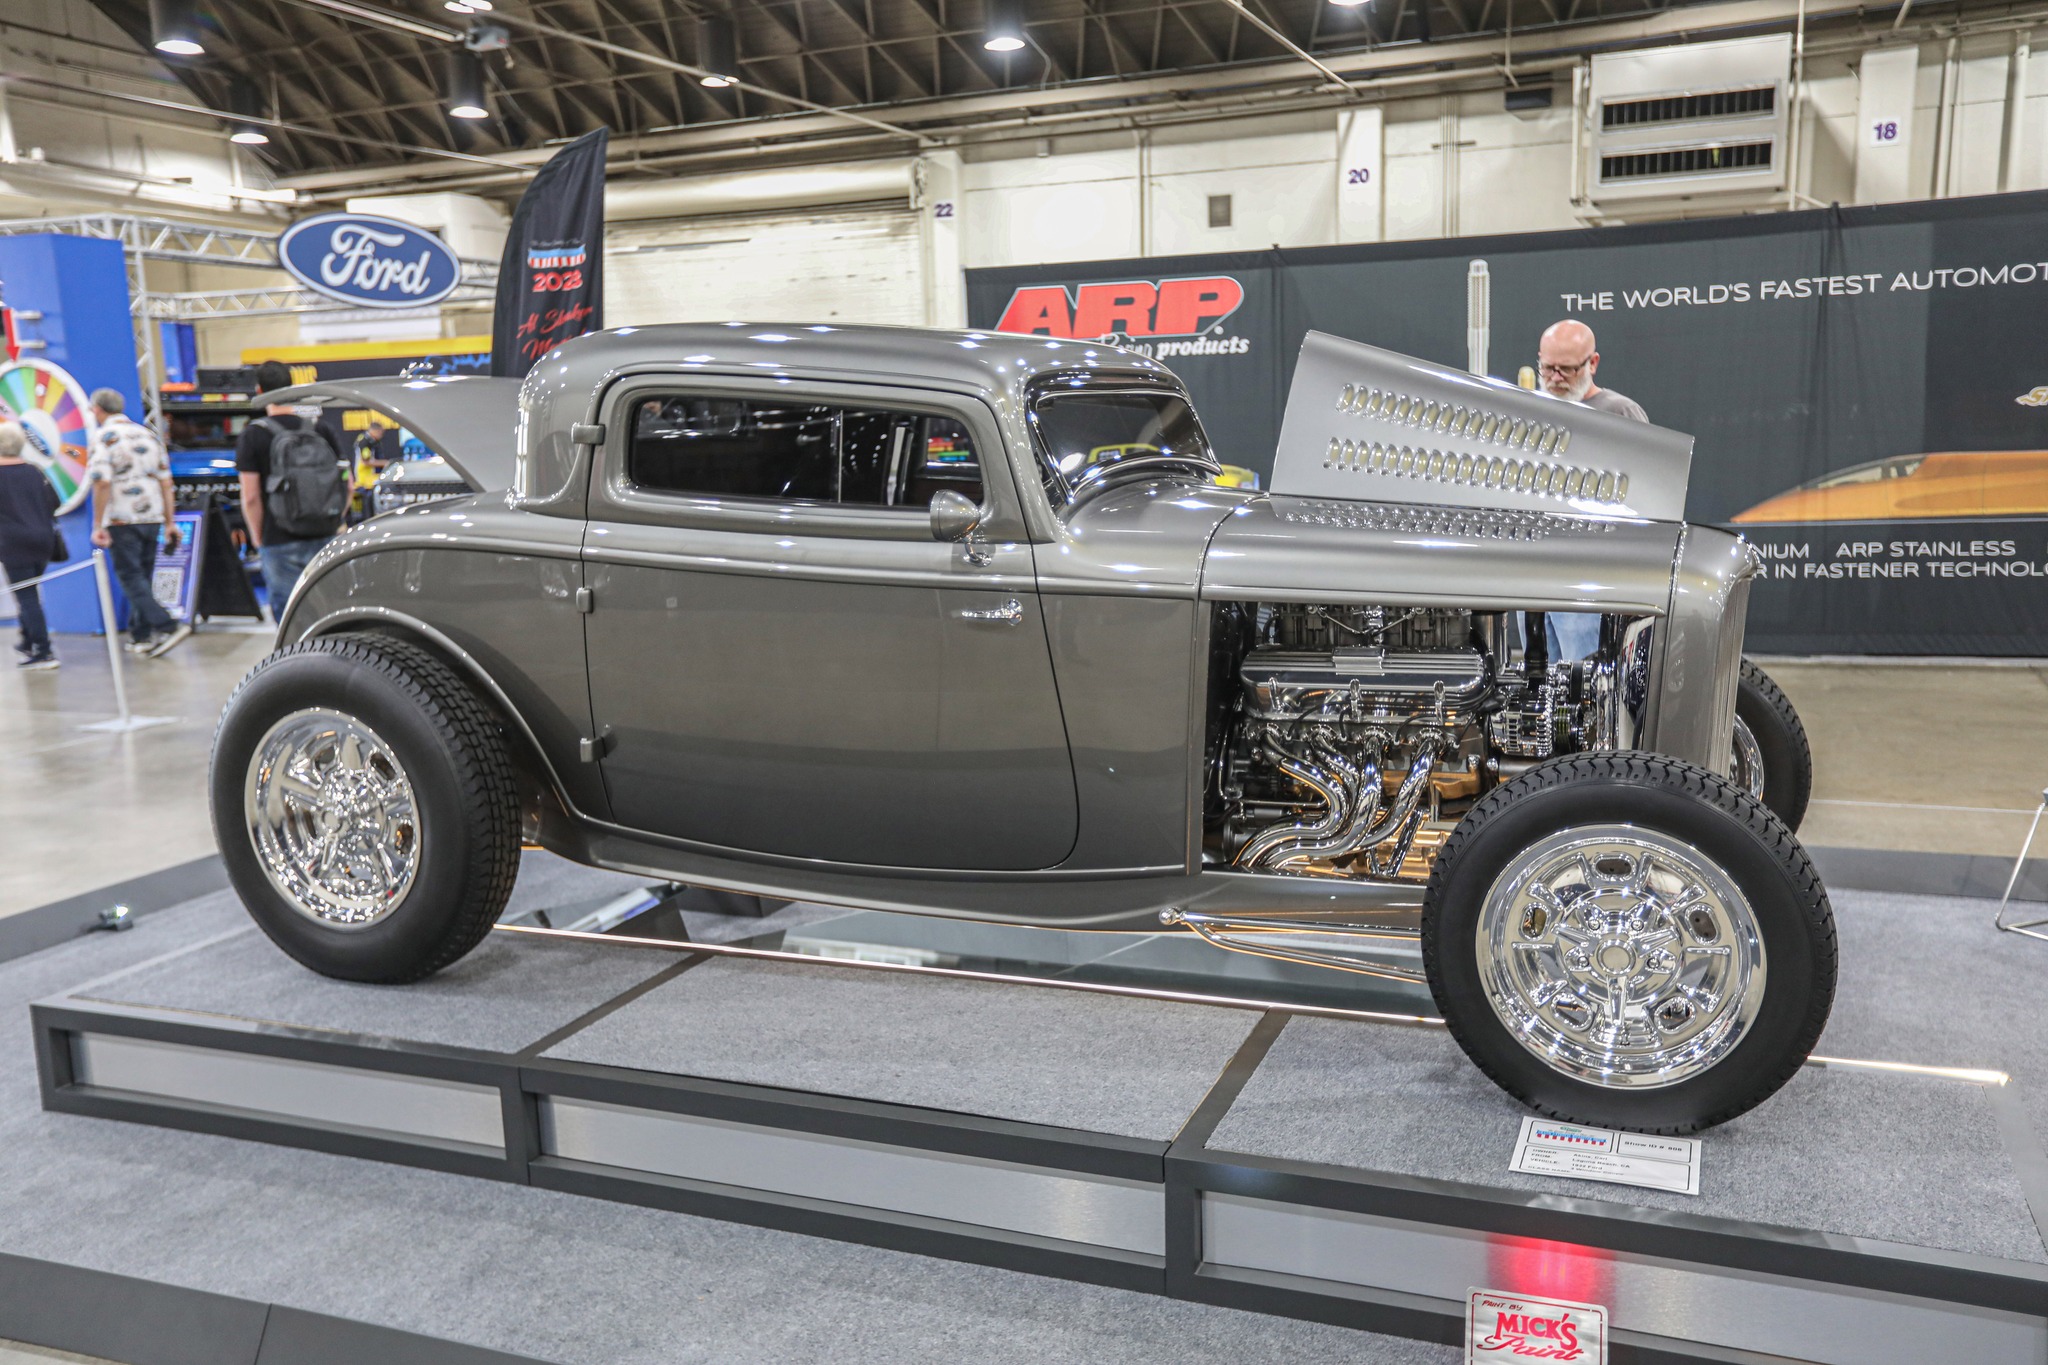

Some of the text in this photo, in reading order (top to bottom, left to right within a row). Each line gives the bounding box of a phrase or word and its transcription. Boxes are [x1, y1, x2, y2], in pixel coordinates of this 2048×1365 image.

[1873, 122, 1897, 141] 18
[1348, 168, 1369, 184] 20
[934, 203, 954, 218] 22
[320, 223, 431, 295] Ford
[531, 269, 584, 293] 2023
[1560, 291, 1614, 312] THE
[1622, 282, 1751, 309] WORLD'S
[1760, 273, 1883, 300] FASTEST
[993, 276, 1245, 340] ARP
[1155, 335, 1250, 361] products
[1835, 541, 1884, 558] ARP
[1889, 540, 2016, 558] STAINLESS
[1774, 562, 1797, 579] IN
[1803, 561, 1919, 579] FASTENER
[1926, 560, 2048, 578] TECHNOL
[1482, 1299, 1506, 1309] PAINT
[1493, 1311, 1578, 1351] MICK'S
[1476, 1334, 1584, 1361] Paint
